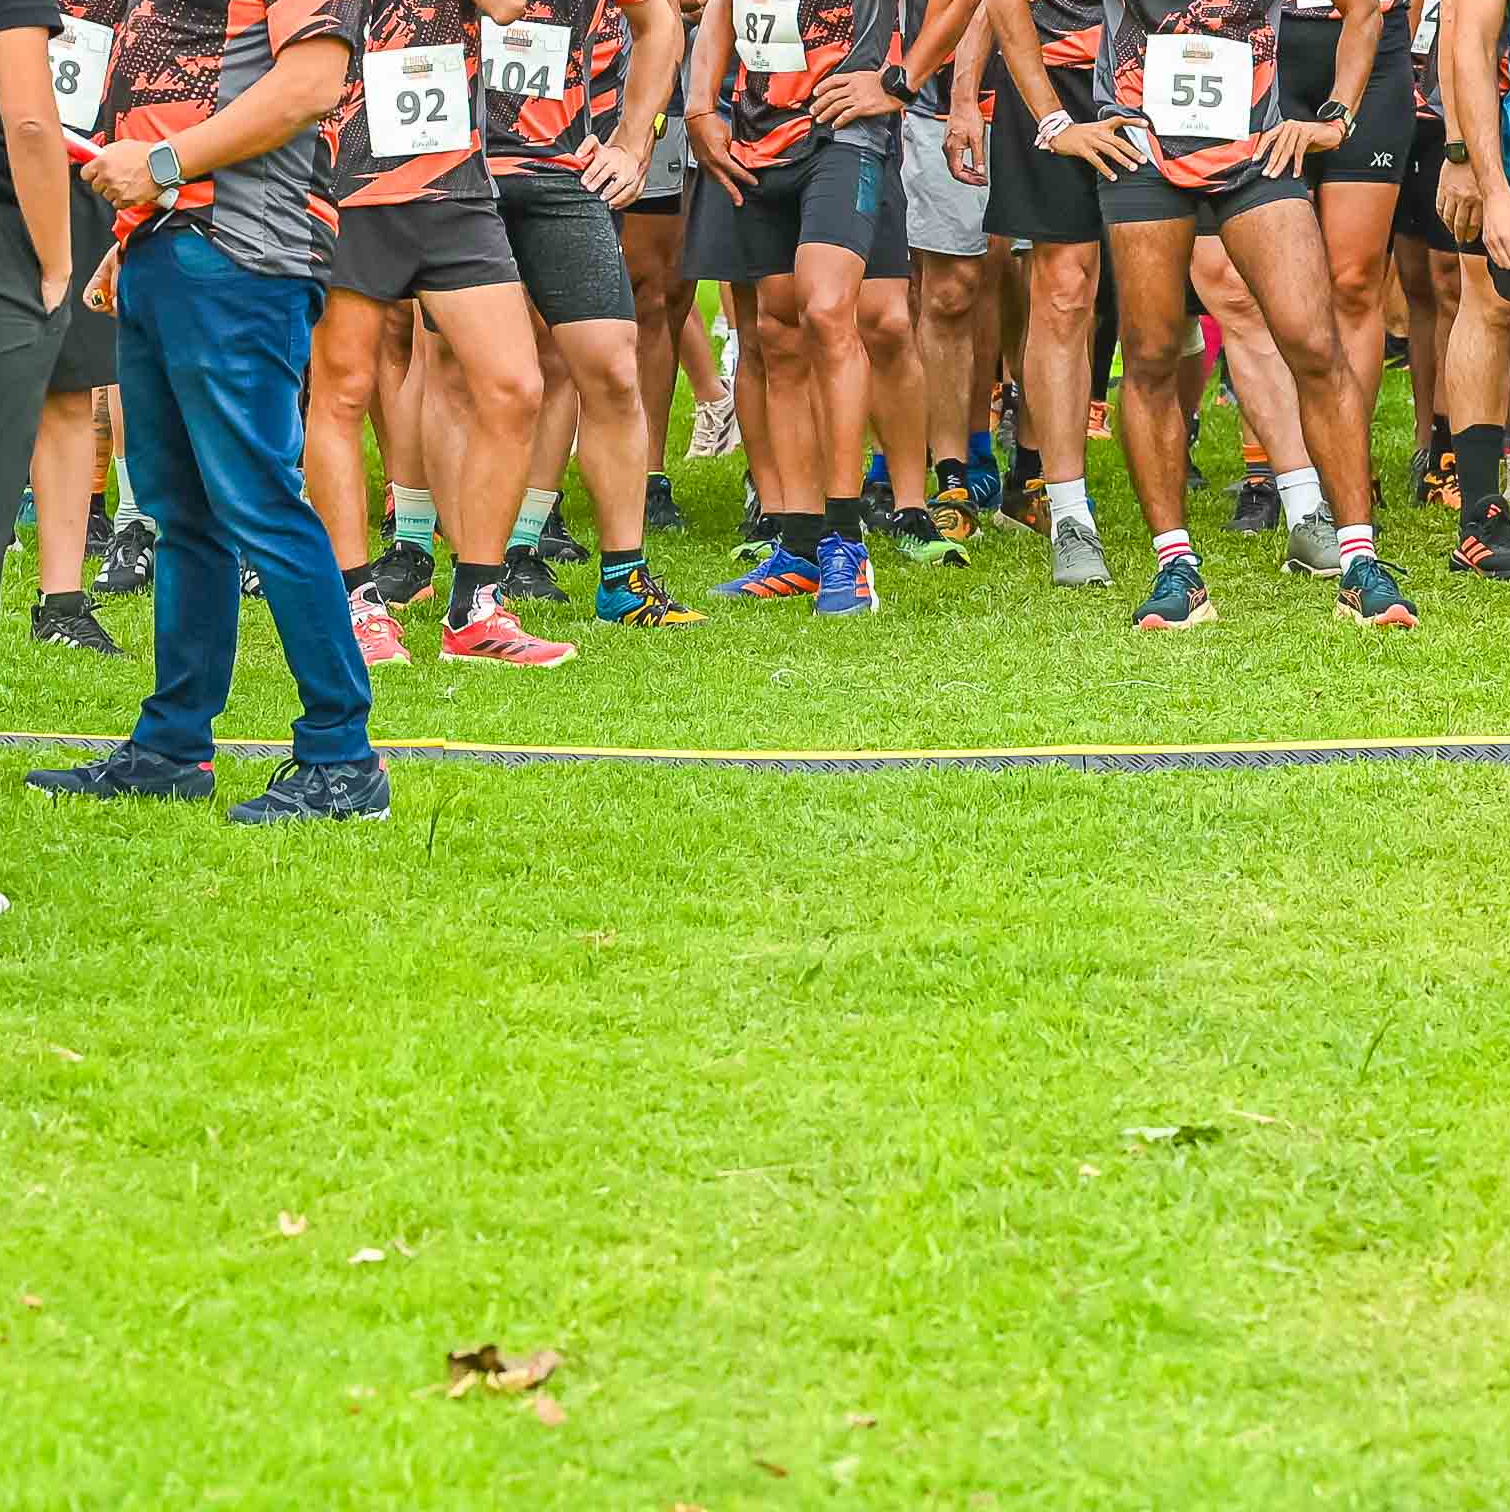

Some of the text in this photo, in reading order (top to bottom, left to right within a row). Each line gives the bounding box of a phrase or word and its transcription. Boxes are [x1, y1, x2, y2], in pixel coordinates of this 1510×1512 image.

[745, 12, 776, 45] 87
[396, 88, 448, 125] 92
[1171, 73, 1223, 108] 55
[1370, 151, 1393, 168] XR
